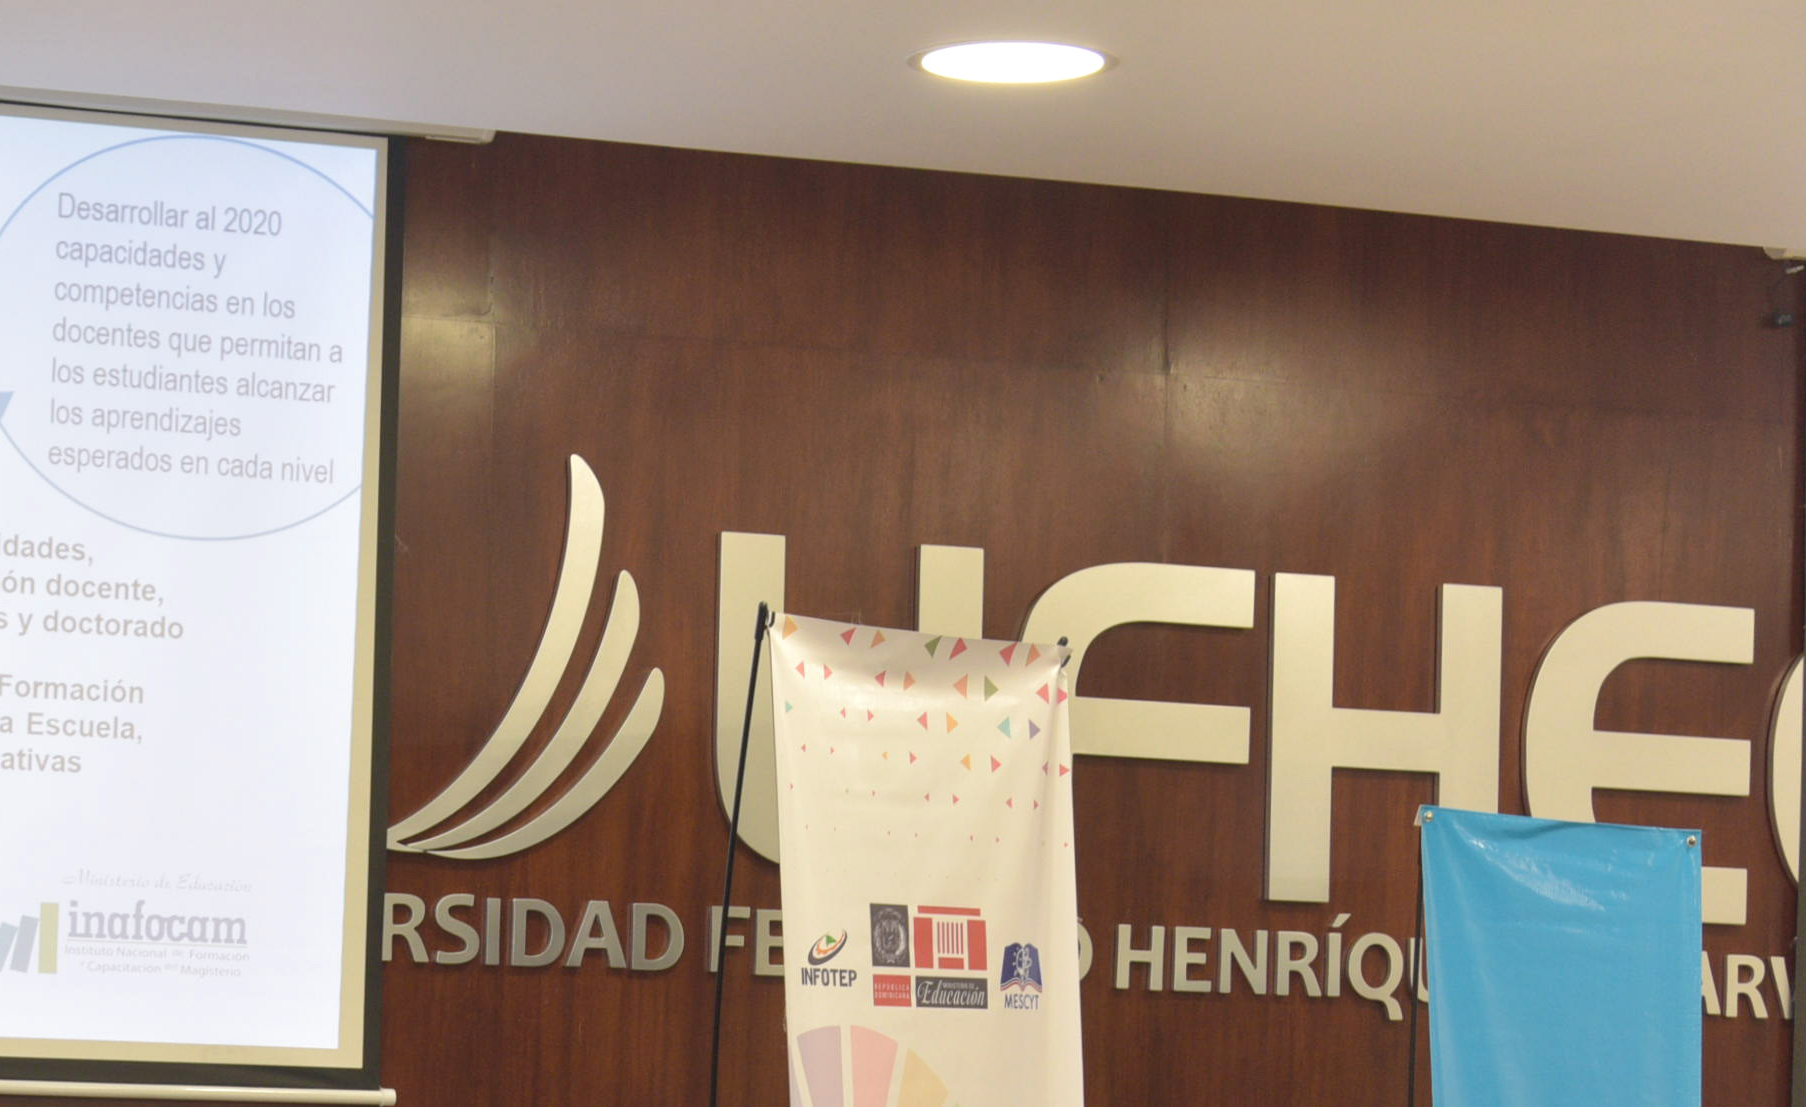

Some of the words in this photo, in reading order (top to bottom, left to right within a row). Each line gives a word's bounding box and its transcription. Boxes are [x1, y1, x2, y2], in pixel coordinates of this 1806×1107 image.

[57, 192, 188, 232] Desarrollar
[223, 207, 282, 237] 2020
[55, 236, 205, 272] capacidades
[54, 279, 218, 314] competencias
[263, 290, 296, 319] los
[52, 318, 161, 349] docentes
[168, 331, 212, 357] que
[220, 331, 321, 366] permitan
[52, 357, 83, 388] los
[92, 360, 228, 395] estudiantes
[236, 371, 336, 402] alcanzar
[50, 399, 83, 427] los
[91, 402, 242, 442] aprendizajes
[48, 440, 172, 478] esperados
[217, 447, 273, 480] cada
[280, 457, 334, 484] nivel
[45, 573, 165, 606] docente,
[42, 609, 185, 640] doctorado
[26, 711, 144, 744] Escuela,
[716, 530, 1803, 925] UFHE
[68, 899, 247, 944] inafocam
[381, 892, 685, 971] RSIDAD
[801, 967, 857, 988] INFOTEP
[1115, 913, 1429, 1021] HENRÍQ
[917, 980, 985, 1006] Educación
[1004, 993, 1038, 1010] MESCYT
